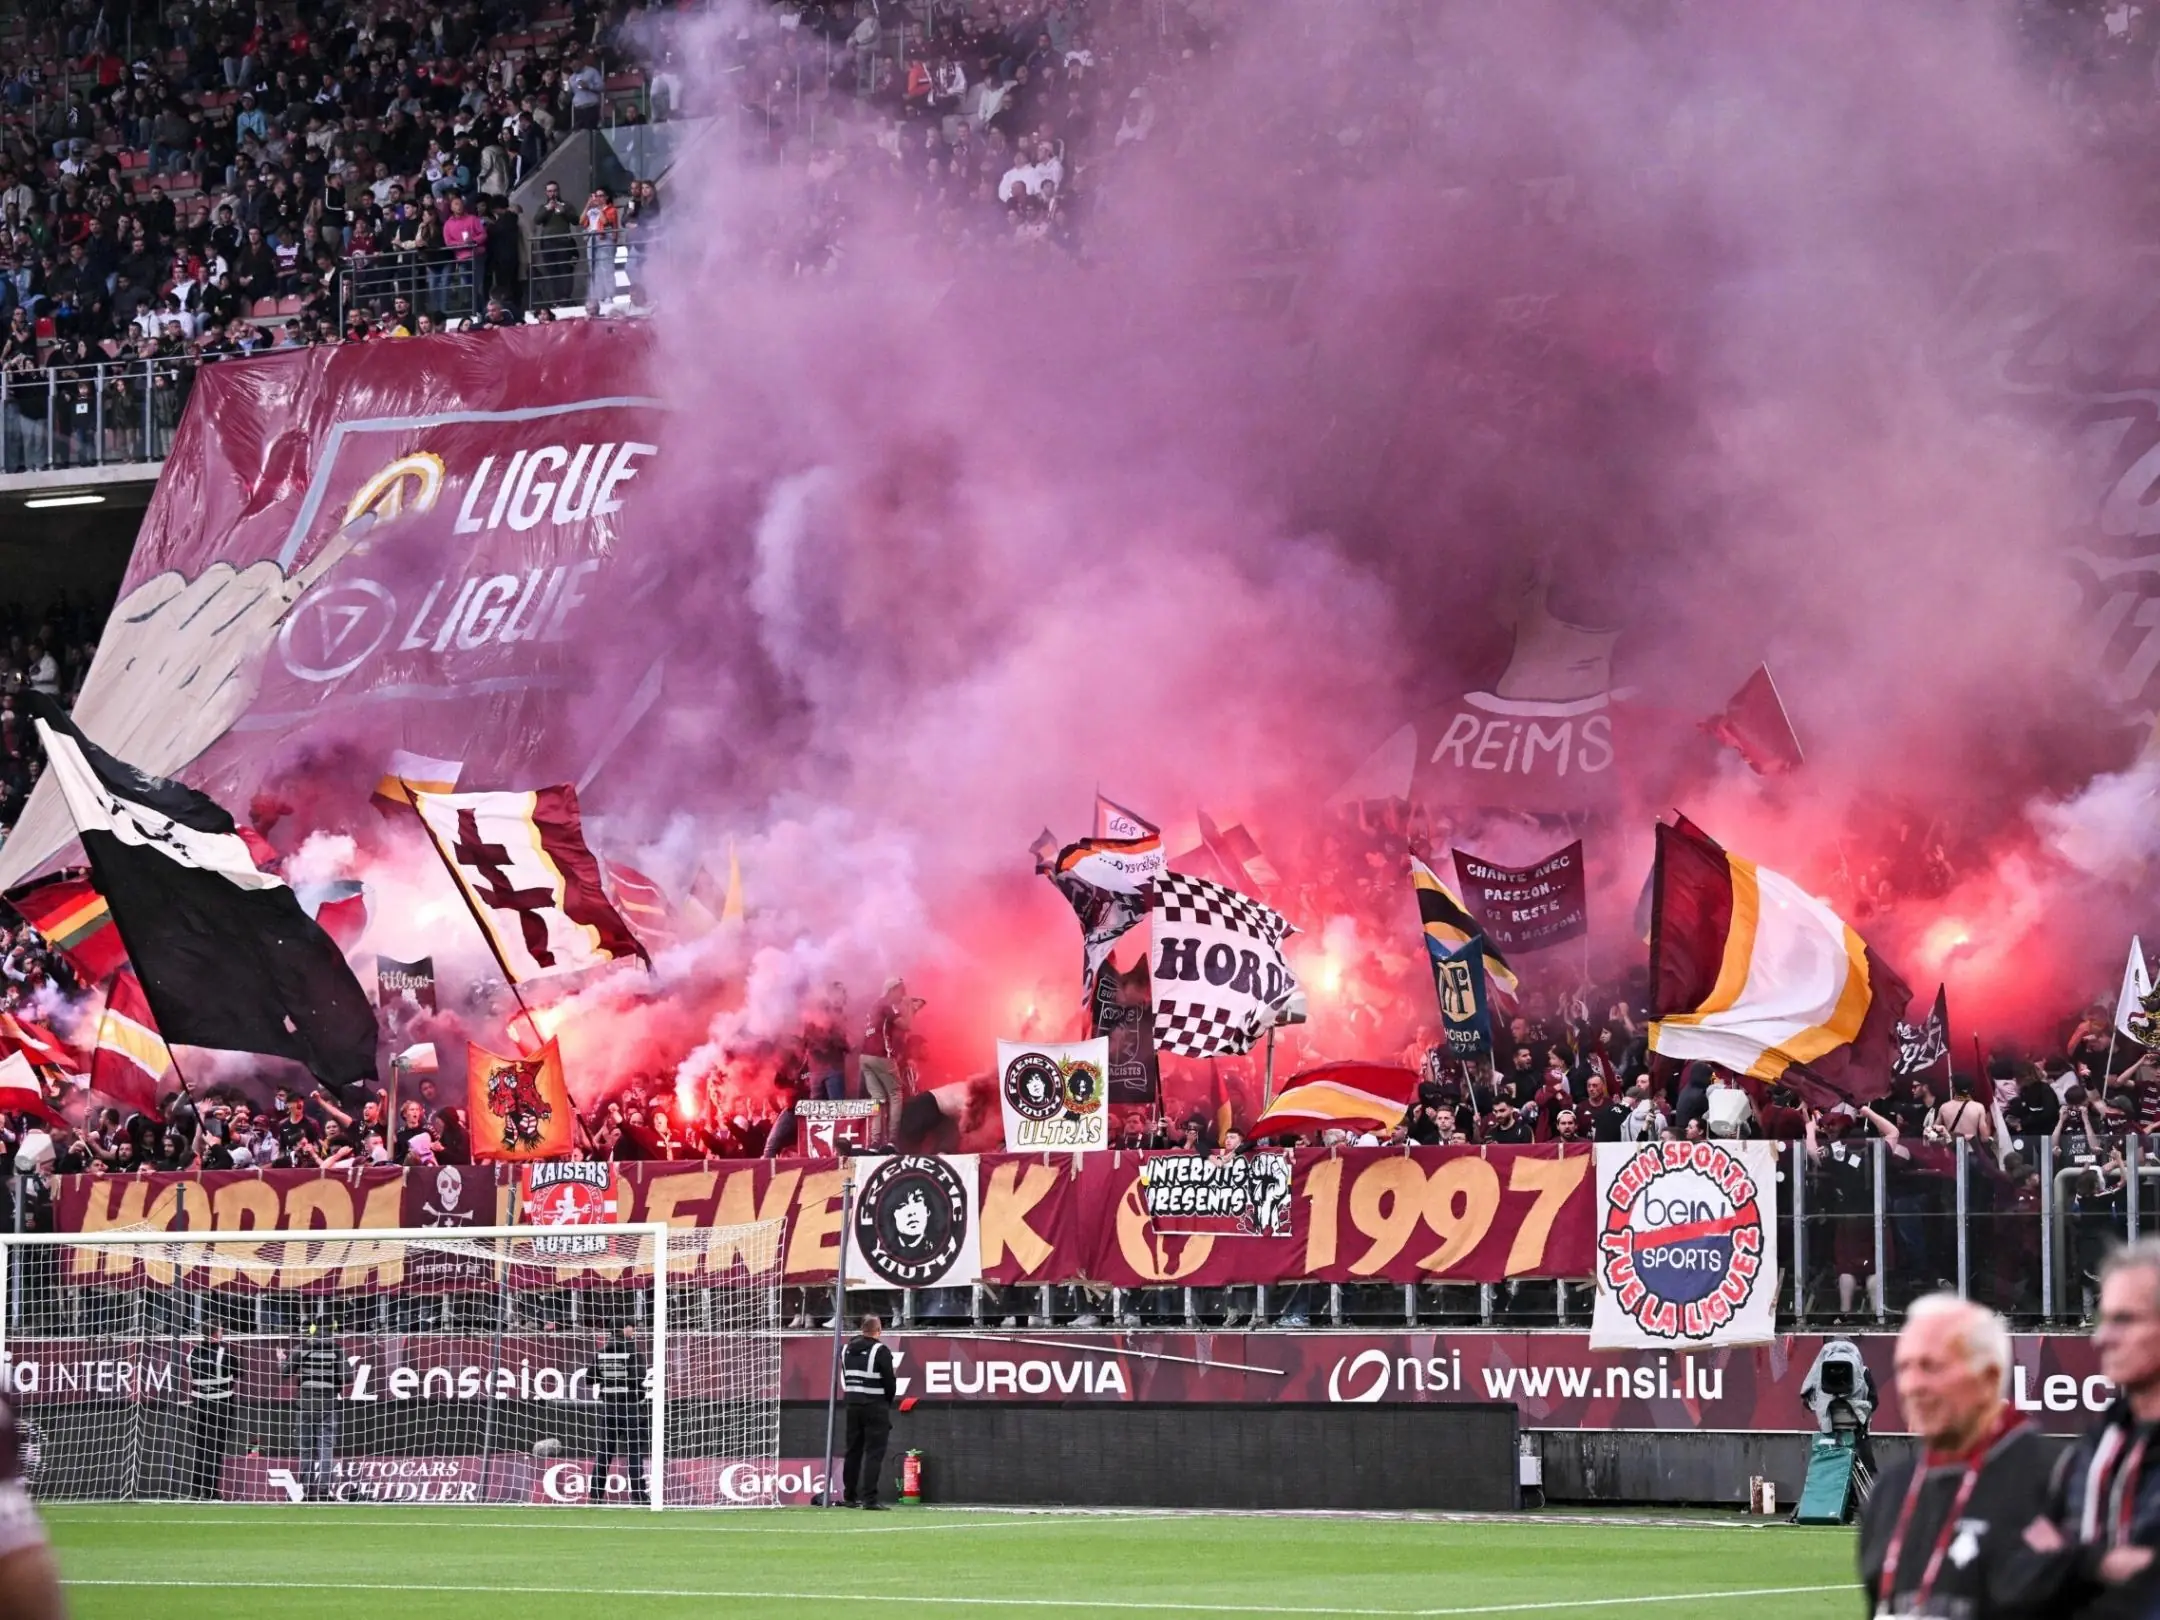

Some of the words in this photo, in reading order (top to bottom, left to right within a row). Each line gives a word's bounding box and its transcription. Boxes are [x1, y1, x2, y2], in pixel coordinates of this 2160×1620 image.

[453, 441, 658, 535] LIGUE
[1467, 862, 1526, 882] CHANTE
[1535, 855, 1570, 878] AVEC
[1512, 899, 1560, 922] RESTE
[1109, 1066, 1142, 1077] ACISTES
[1017, 1116, 1102, 1146] ULTRAS
[530, 1162, 608, 1189] KAISERS
[1147, 1156, 1246, 1184] INTERDITS
[1608, 1147, 1665, 1211] BEIN
[1663, 1141, 1756, 1208] SPORTS
[861, 1155, 963, 1226] FRENETIC
[1302, 1155, 1591, 1277] 1997
[871, 1233, 957, 1279] YOUTH
[1642, 1247, 1722, 1272] SPORTS
[1602, 1230, 1647, 1312] TUE
[1638, 1294, 1678, 1336] LA
[1685, 1251, 1760, 1334] LIGUE
[50, 1360, 173, 1393] INTERIM
[926, 1361, 1127, 1394] EUROVIA
[1398, 1349, 1461, 1391] nsi
[1481, 1356, 1723, 1400] www.nsi.lu
[2014, 1365, 2117, 1412] Lec
[333, 1461, 460, 1477] AUTOCARS
